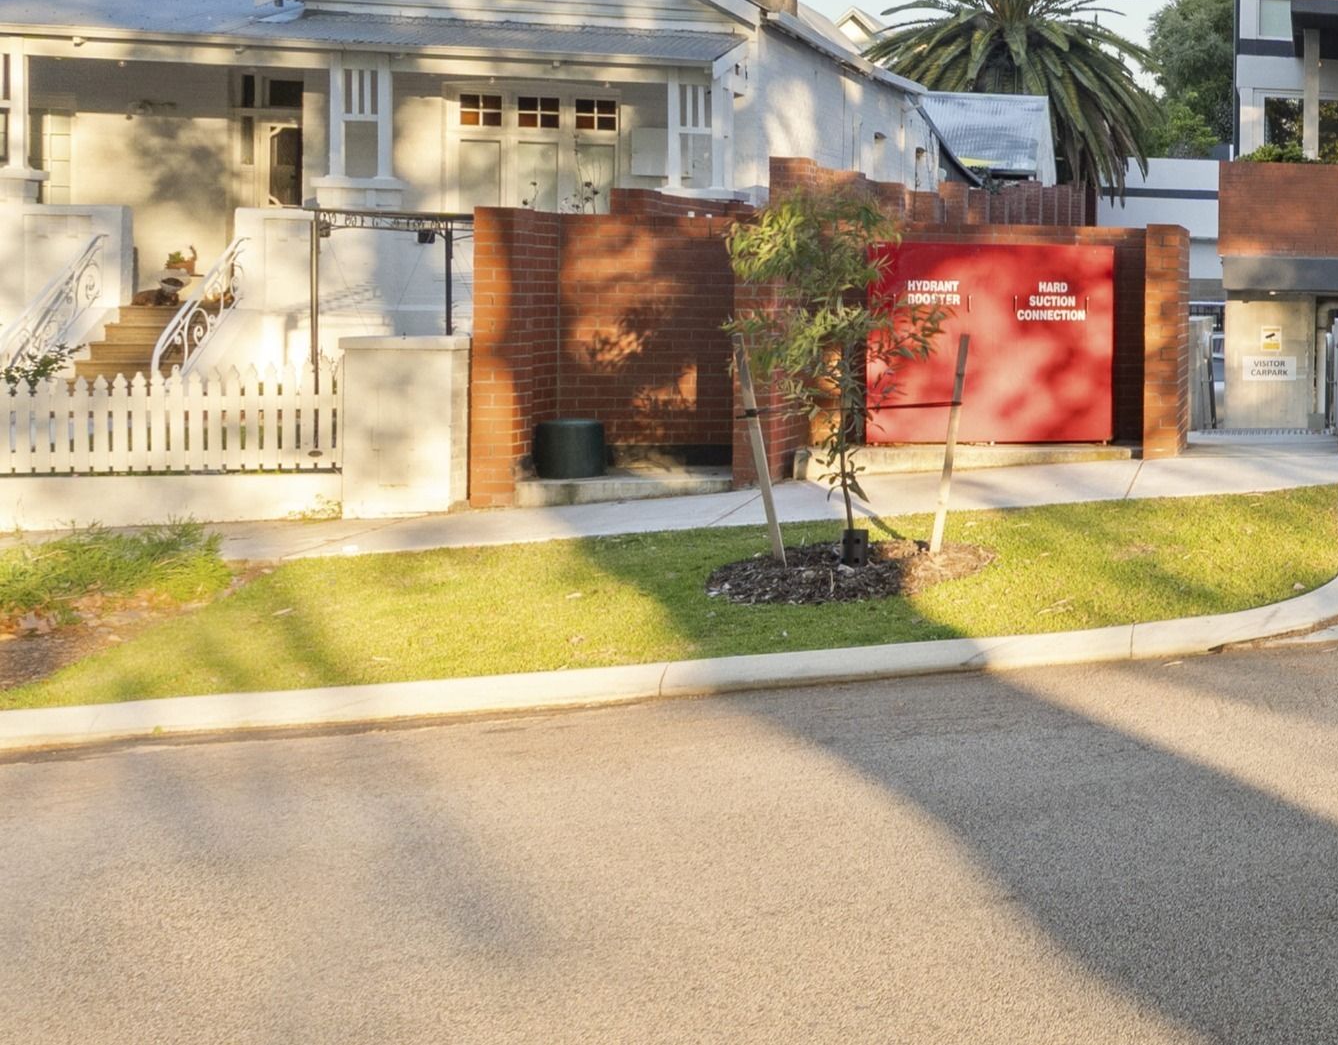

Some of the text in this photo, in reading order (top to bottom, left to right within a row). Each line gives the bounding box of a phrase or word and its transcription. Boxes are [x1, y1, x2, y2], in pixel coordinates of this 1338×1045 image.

[907, 280, 960, 292] HYDRANT
[1038, 281, 1068, 293] HARD
[1029, 295, 1076, 307] SUCTION
[1016, 309, 1086, 321] CONNECTION
